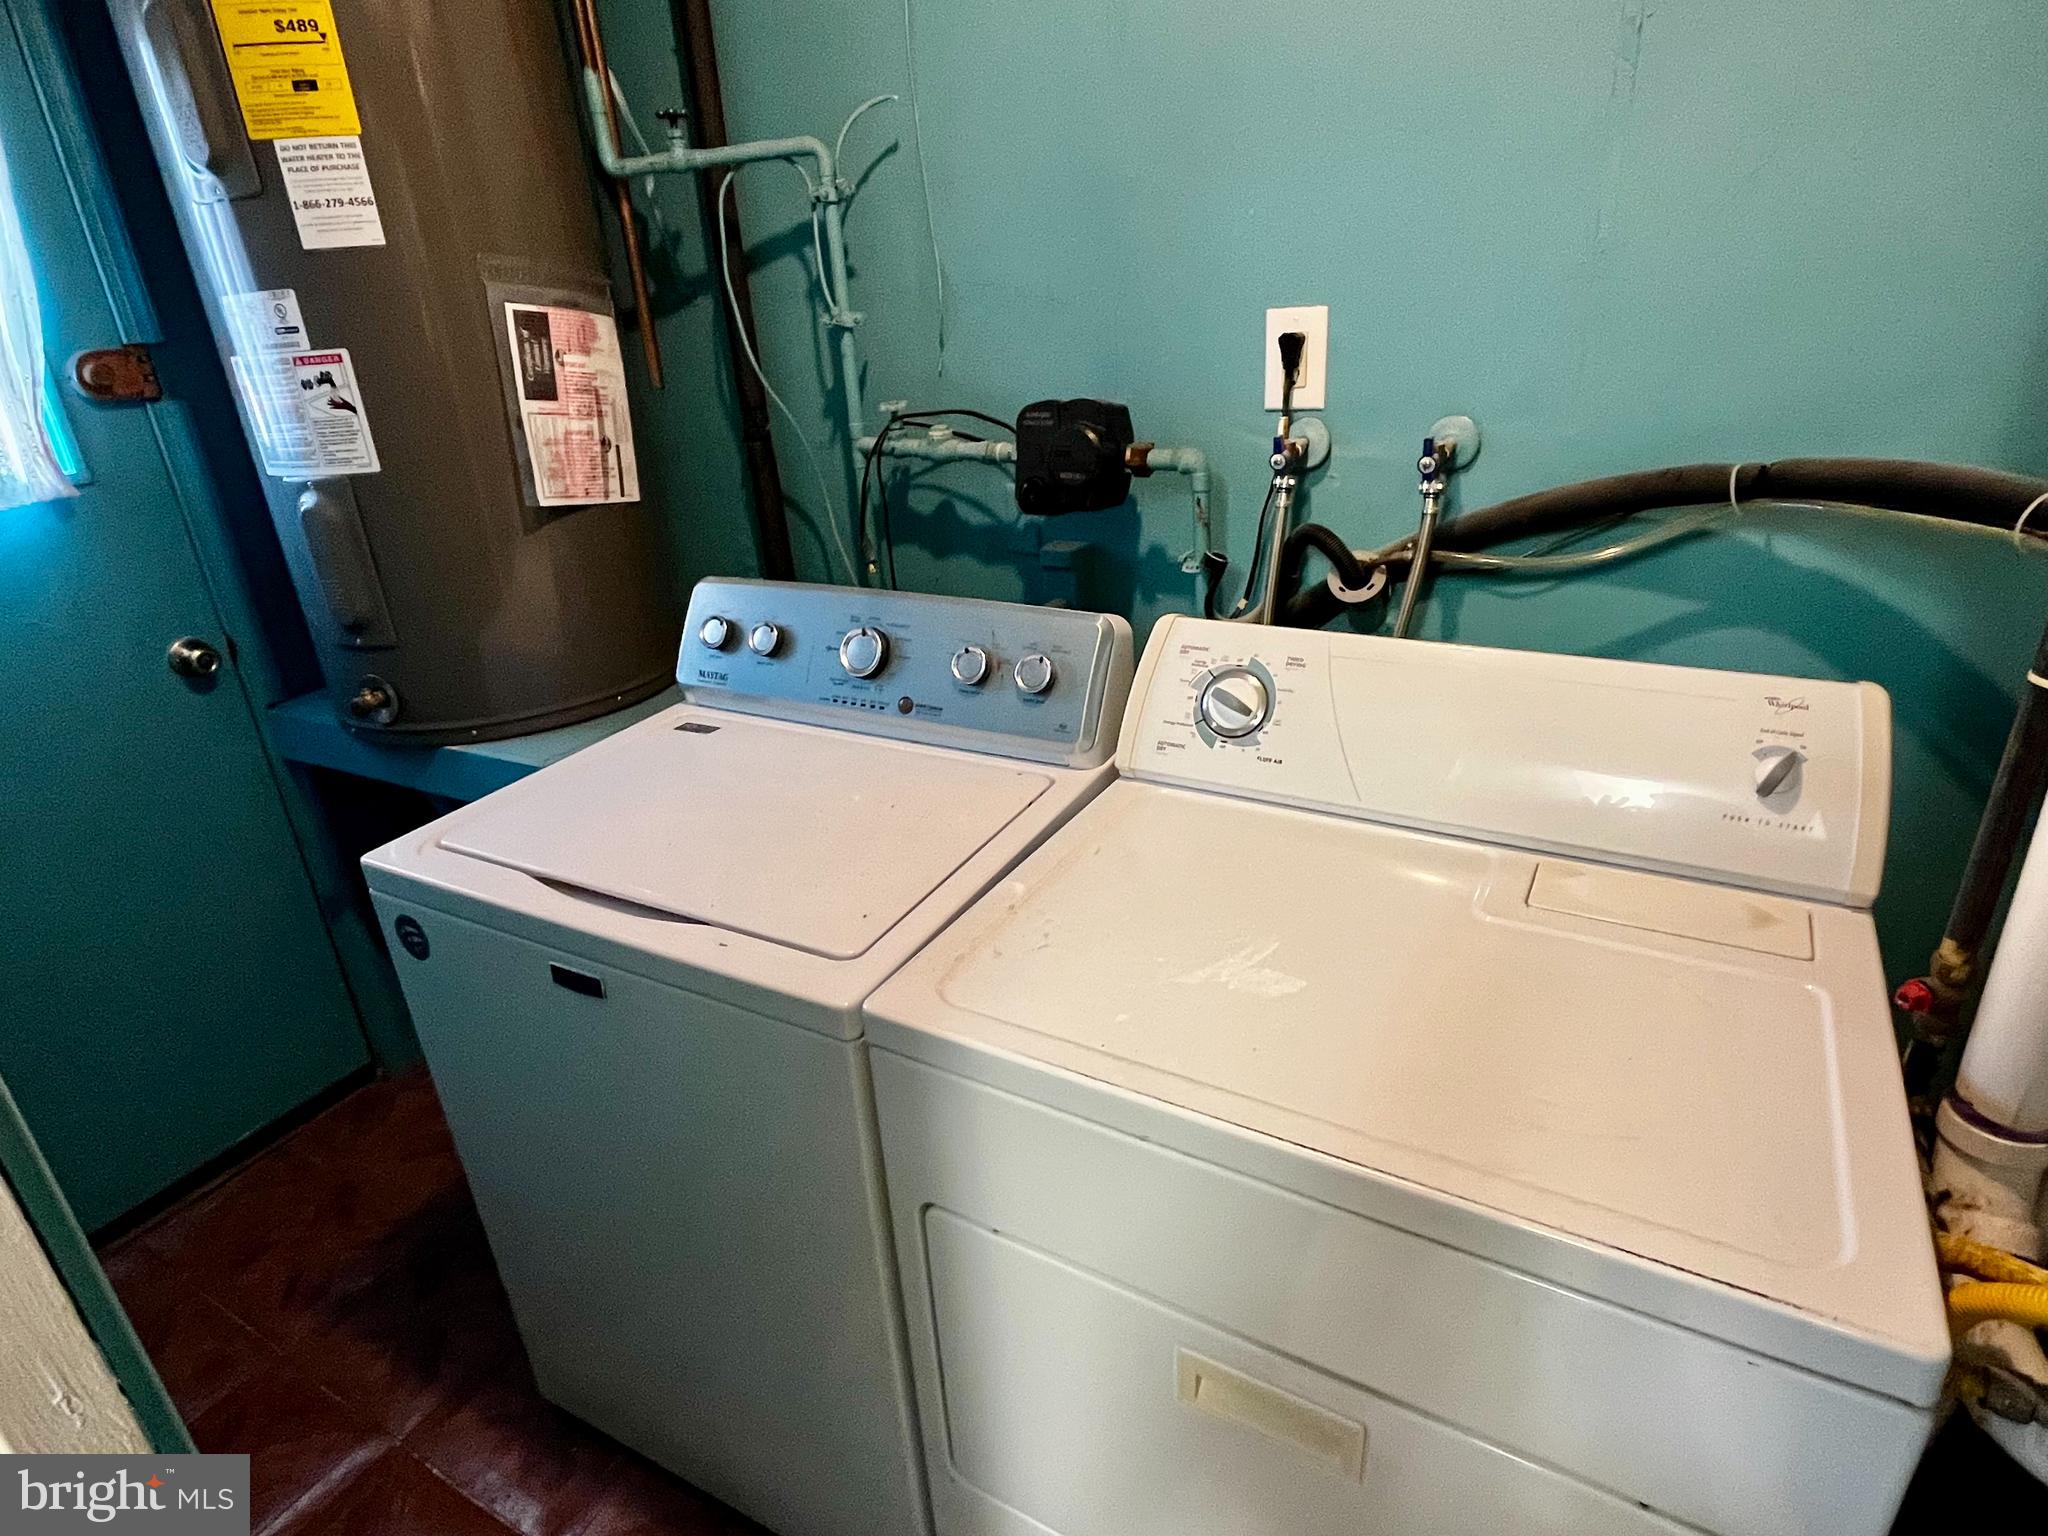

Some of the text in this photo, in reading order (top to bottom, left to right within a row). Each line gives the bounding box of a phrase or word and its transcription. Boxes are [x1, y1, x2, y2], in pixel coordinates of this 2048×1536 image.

[273, 18, 319, 33] $489
[308, 142, 339, 150] RETURN
[281, 155, 306, 163] WATER
[306, 154, 334, 162] HEATER
[347, 152, 362, 160] THE
[287, 163, 360, 174] PLACE OF PURCHASE
[293, 197, 375, 210] 1-866-279-4566
[302, 354, 342, 366] DANGER
[698, 669, 729, 682] MAYTAG
[1765, 697, 1810, 713] Whirlpool
